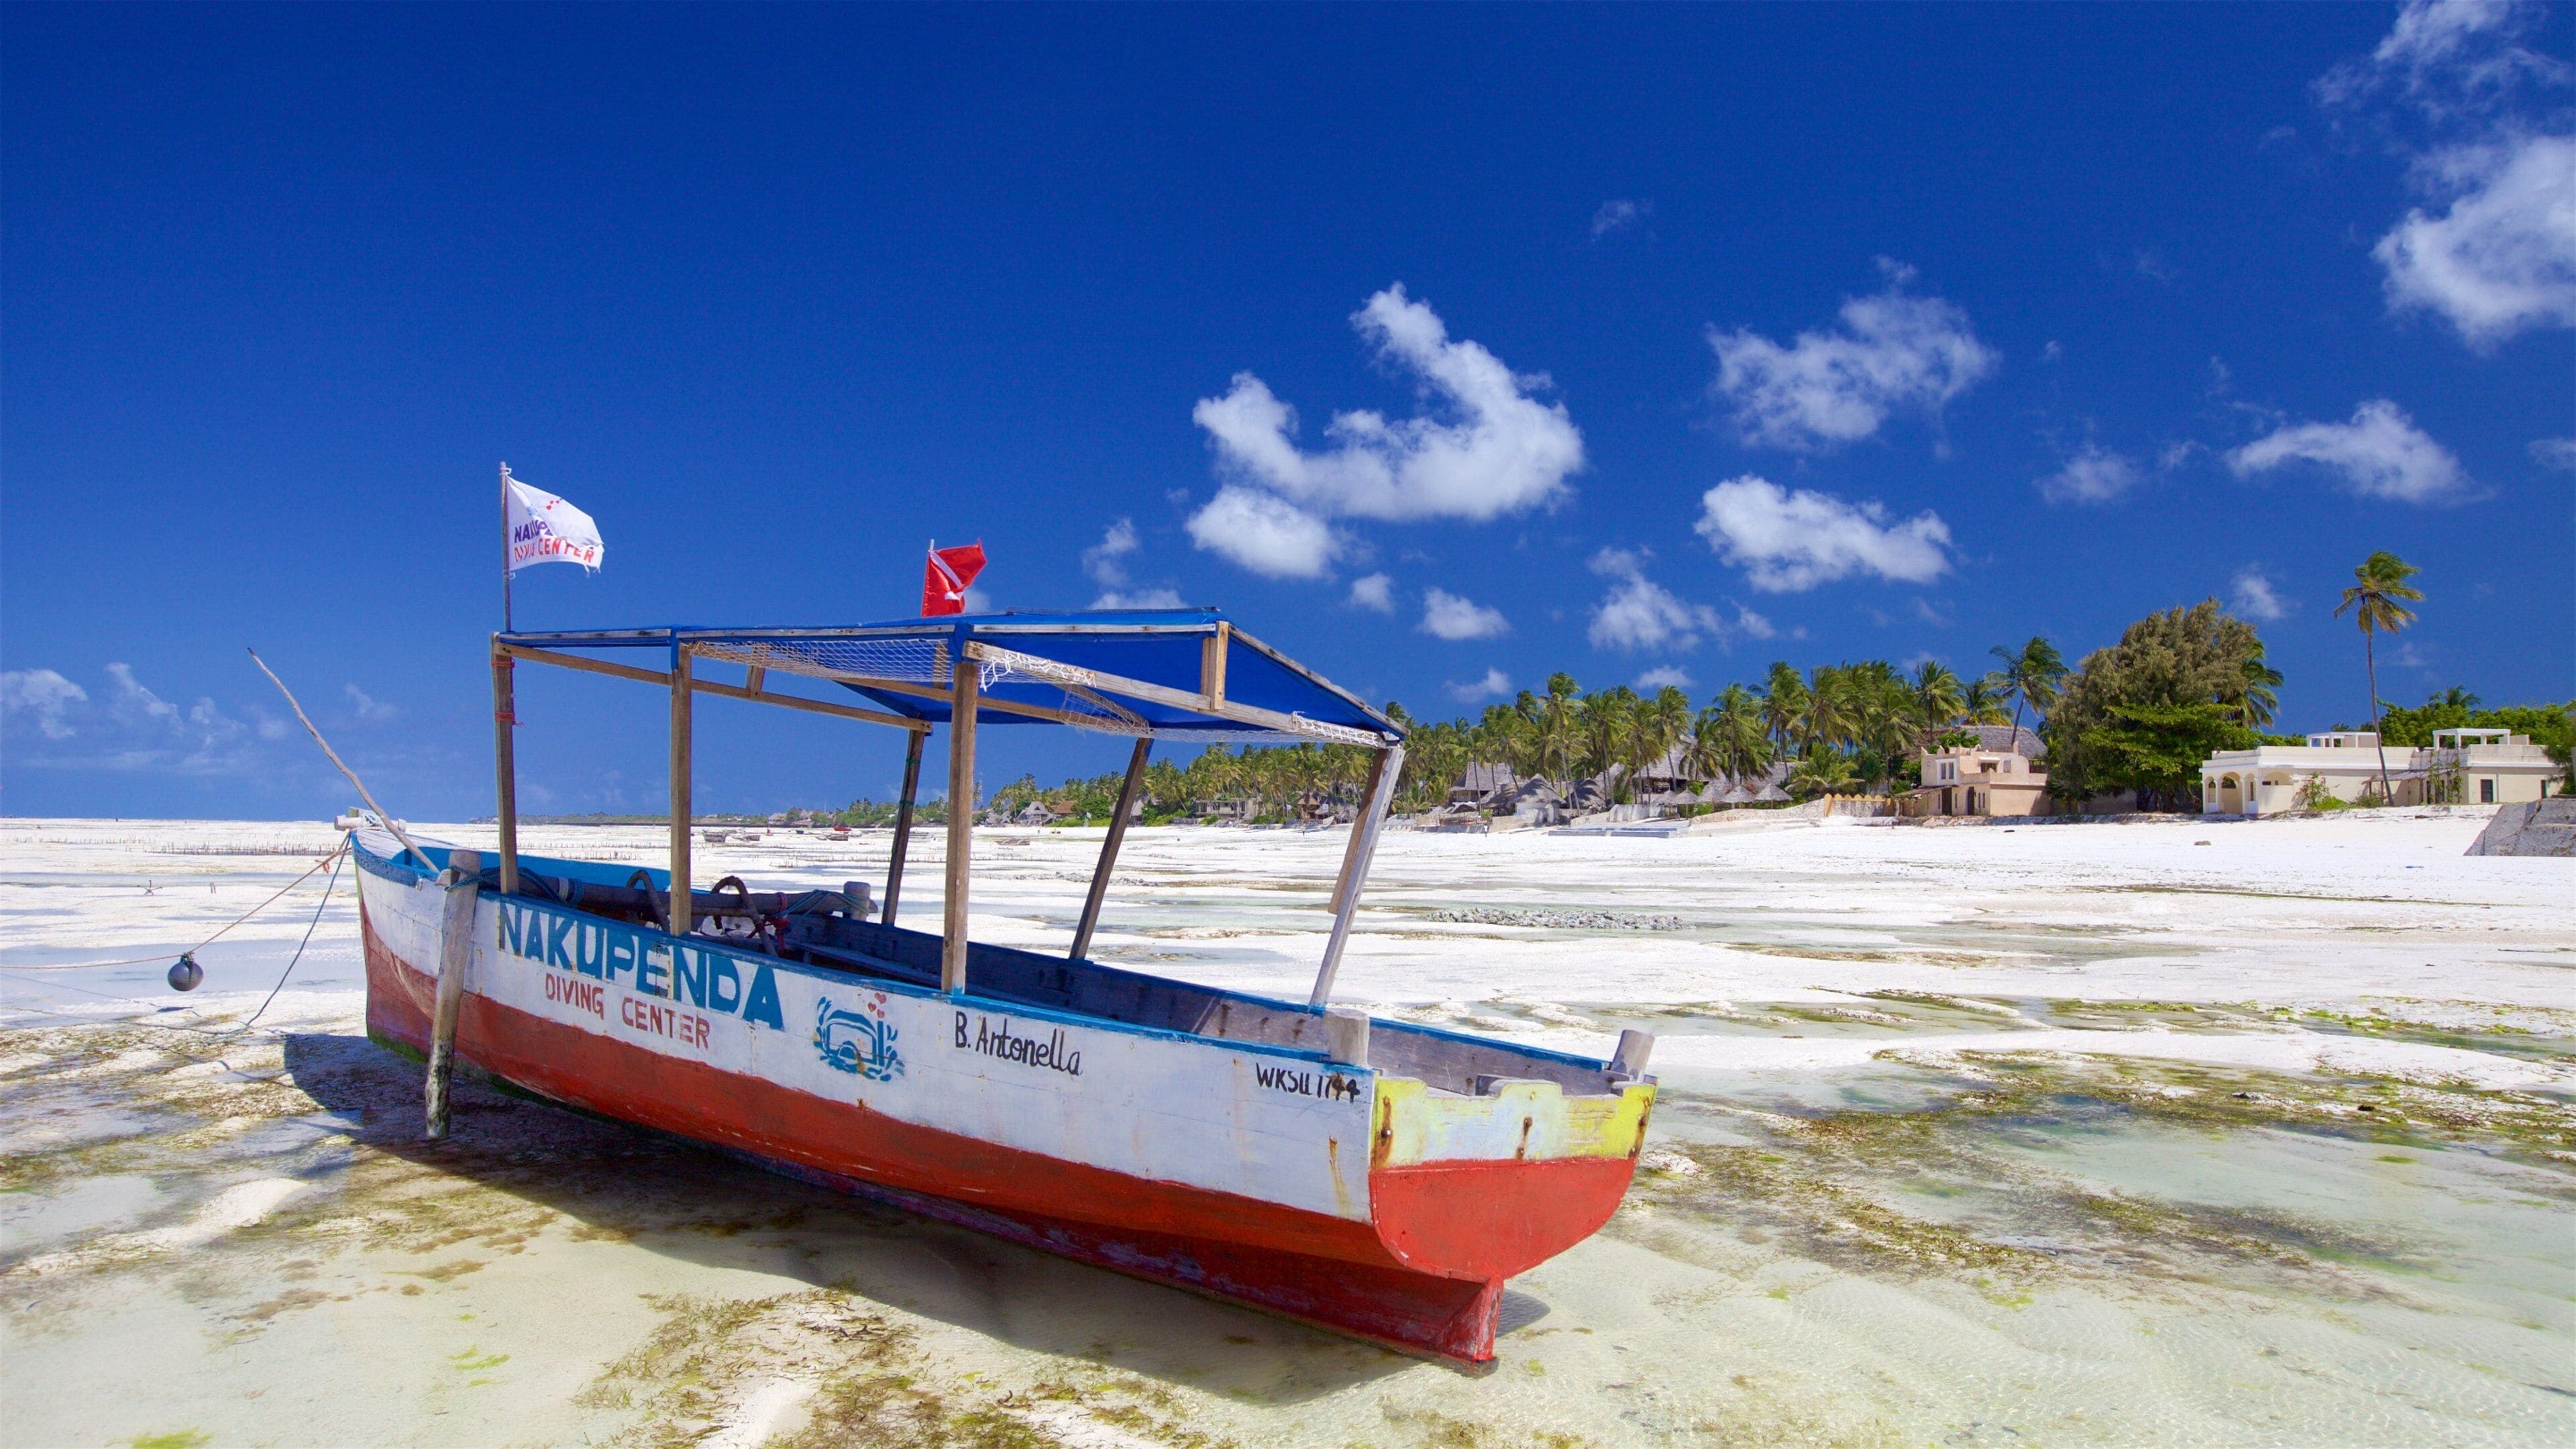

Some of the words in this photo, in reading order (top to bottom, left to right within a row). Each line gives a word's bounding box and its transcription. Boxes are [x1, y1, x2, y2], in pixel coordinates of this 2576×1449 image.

[498, 902, 785, 1031] NAKUPENDA
[545, 973, 604, 1020] DIVING
[621, 996, 710, 1051] CENTER
[955, 1011, 971, 1049] B.
[975, 1017, 1081, 1076] Antonella
